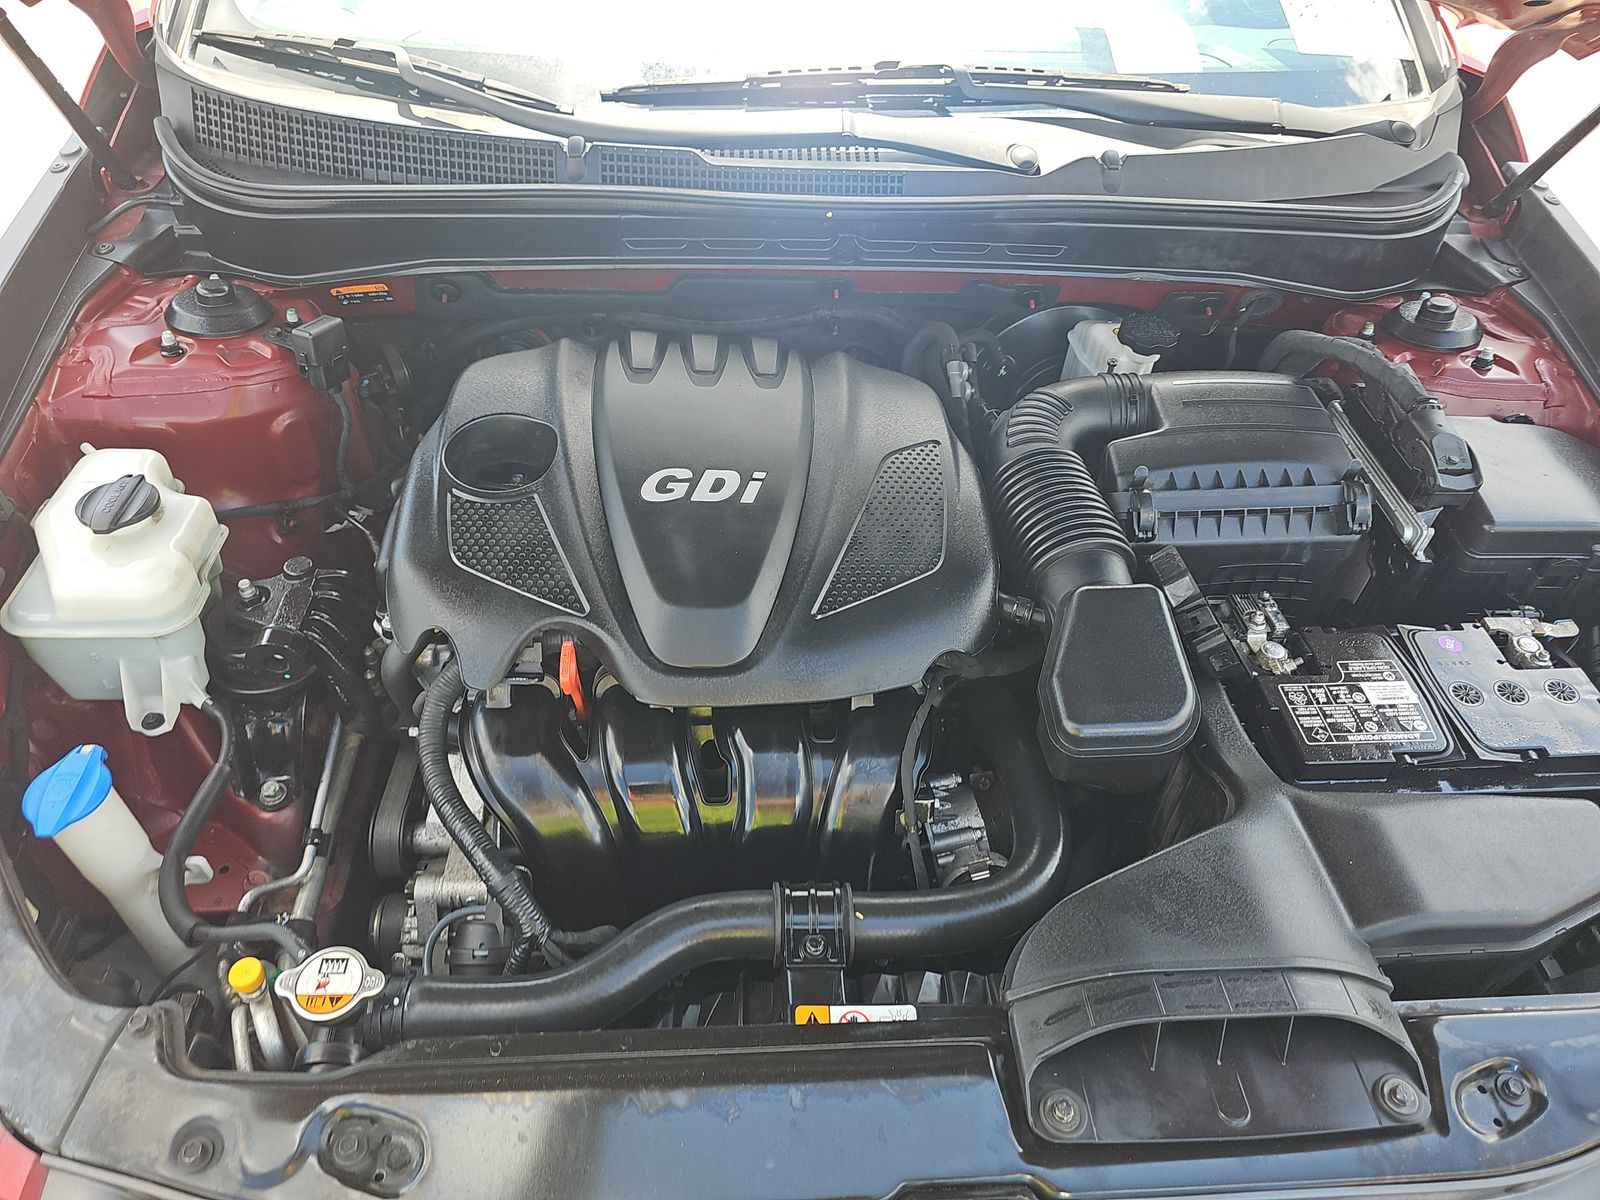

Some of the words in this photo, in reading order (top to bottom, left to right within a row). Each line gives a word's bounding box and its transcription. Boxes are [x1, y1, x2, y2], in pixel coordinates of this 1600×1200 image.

[102, 480, 130, 514] COOLANT
[640, 467, 768, 504] GDi
[1347, 733, 1414, 741] DANGER/POISON
